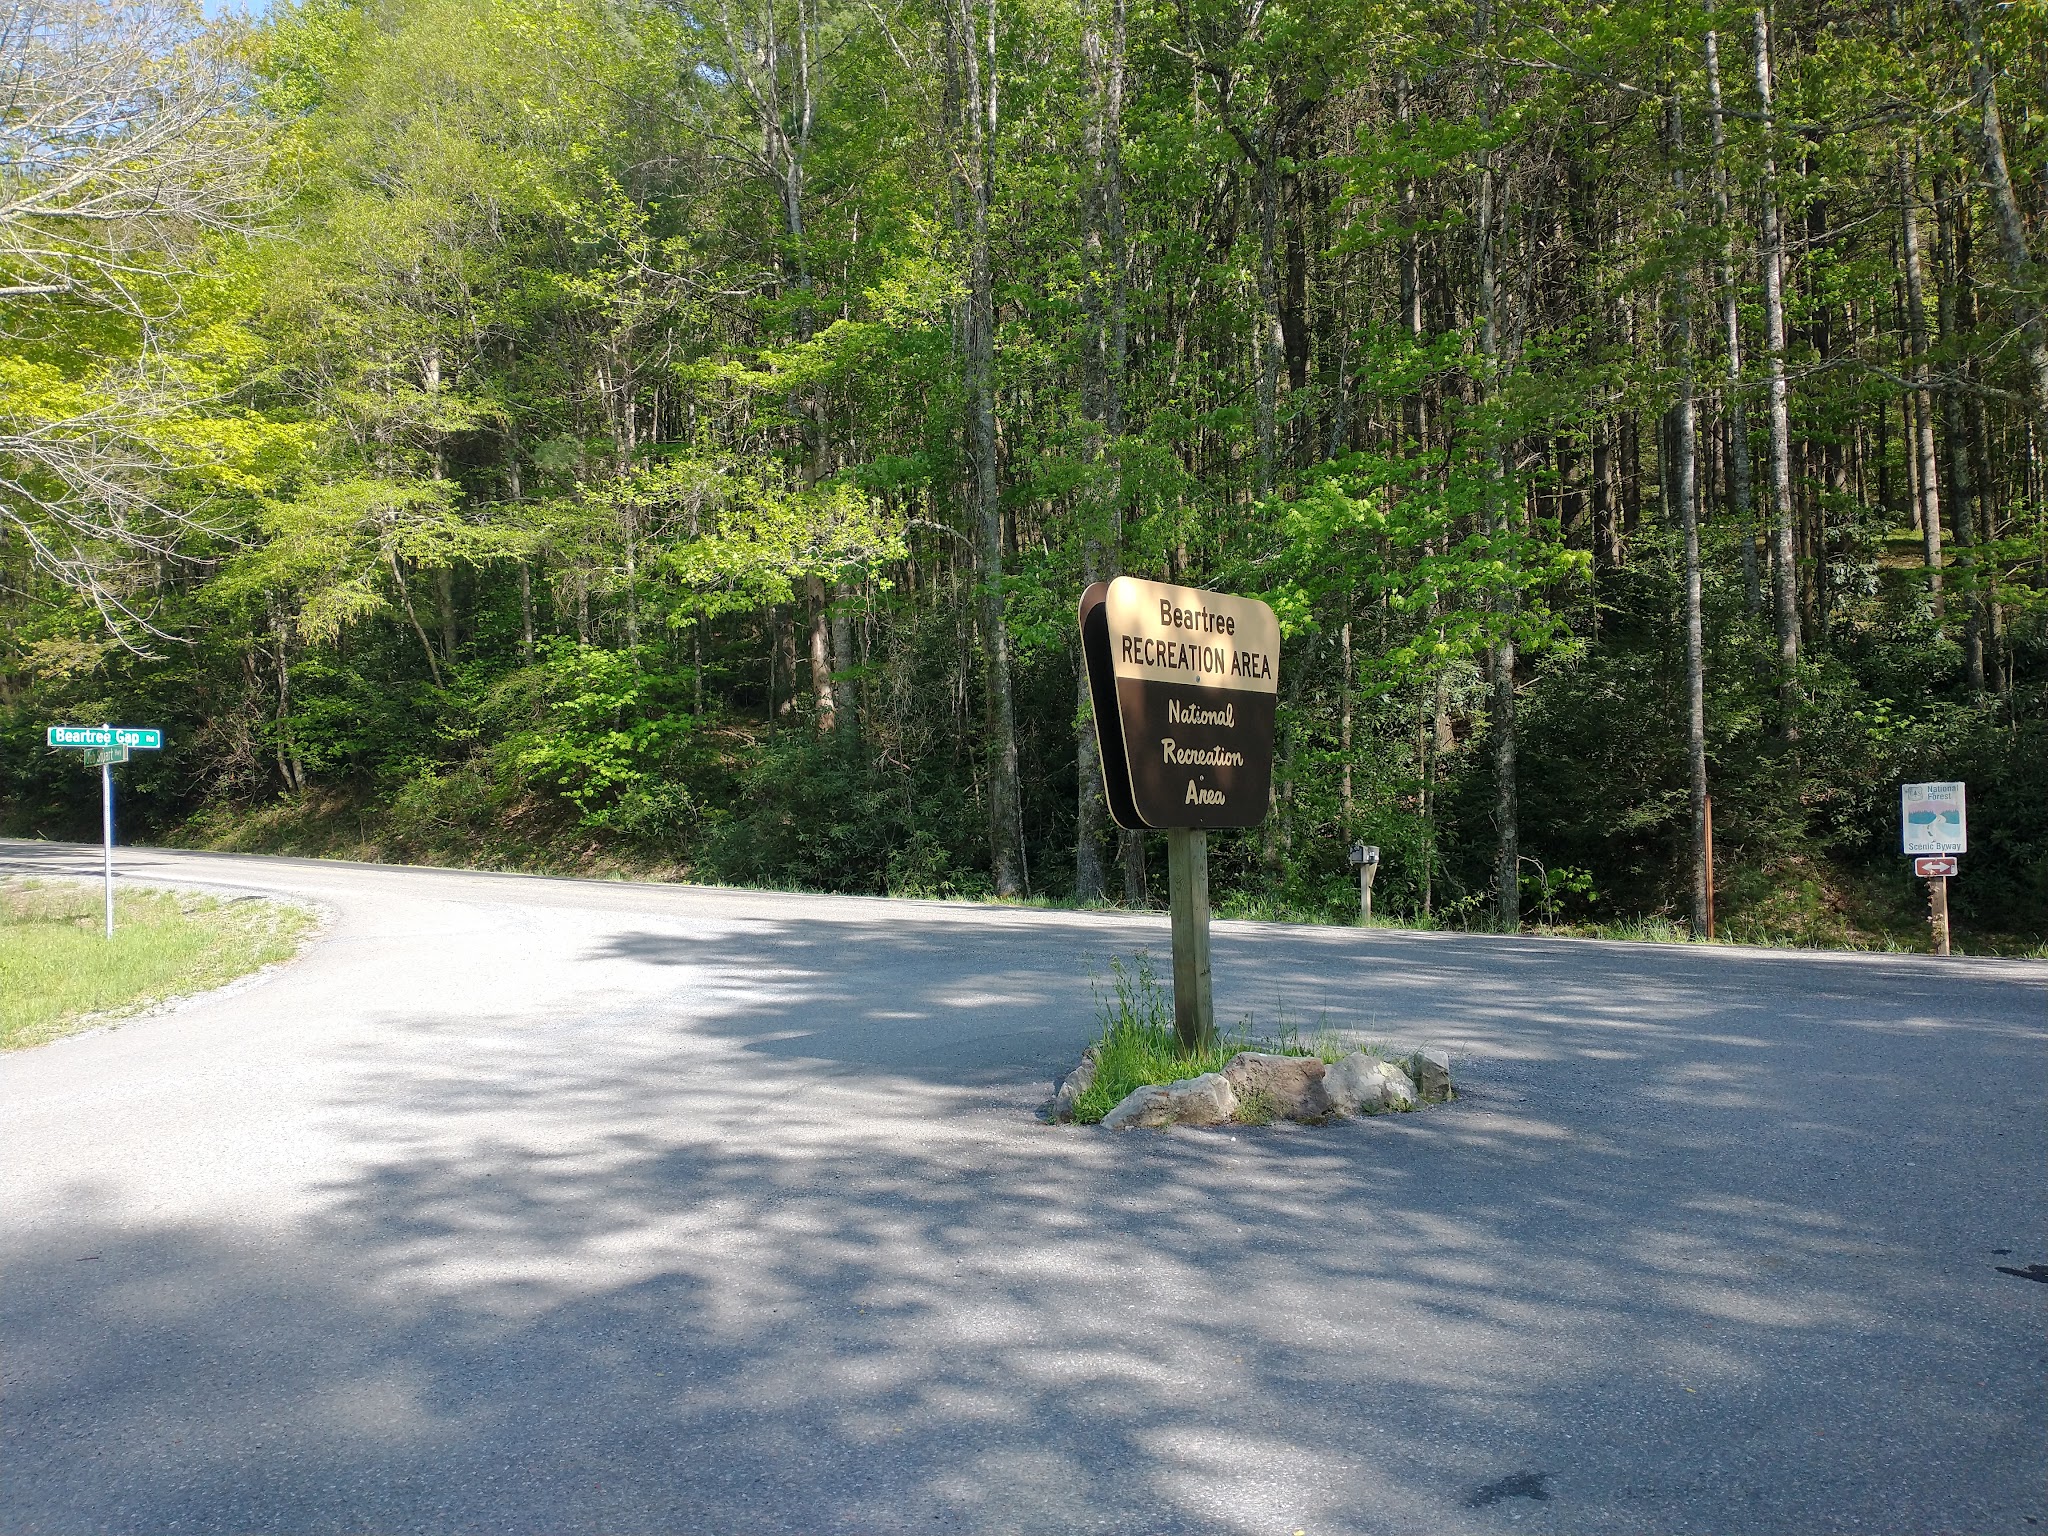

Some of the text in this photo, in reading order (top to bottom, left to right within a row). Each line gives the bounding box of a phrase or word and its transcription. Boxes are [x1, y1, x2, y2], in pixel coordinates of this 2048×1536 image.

[1160, 598, 1236, 636] Beartree
[1122, 635, 1272, 680] RECREATION AREA
[1168, 698, 1235, 728] National
[56, 729, 111, 743] Beartree
[116, 730, 140, 746] Gap
[1161, 738, 1244, 767] Recreation
[1185, 780, 1226, 806] Area
[1927, 785, 1959, 793] National
[1908, 842, 1961, 851] Scenic Byway
